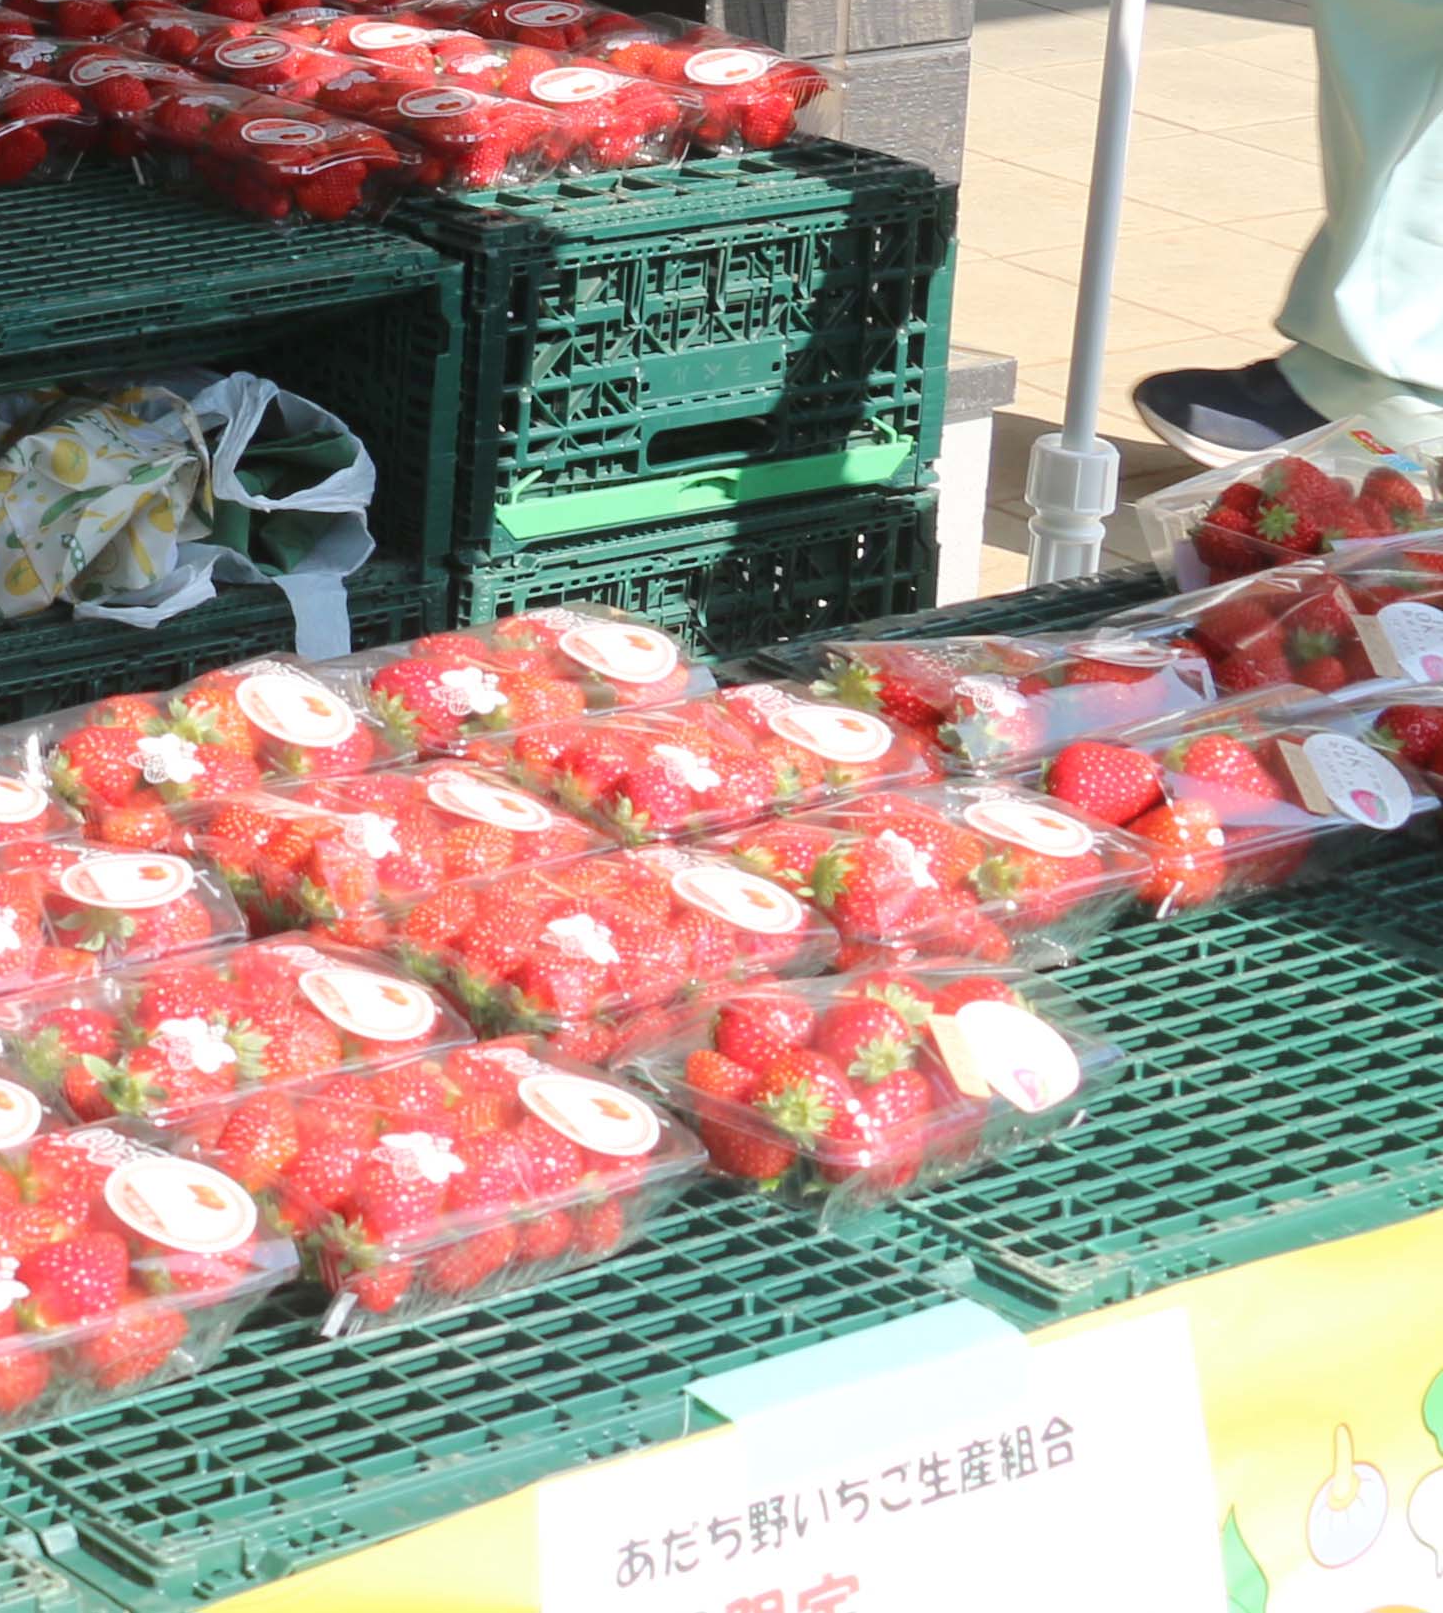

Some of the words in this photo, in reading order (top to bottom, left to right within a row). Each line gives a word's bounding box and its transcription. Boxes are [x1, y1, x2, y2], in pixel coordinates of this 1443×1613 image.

[615, 1415, 1075, 1589] あだち野いちご生産組合
